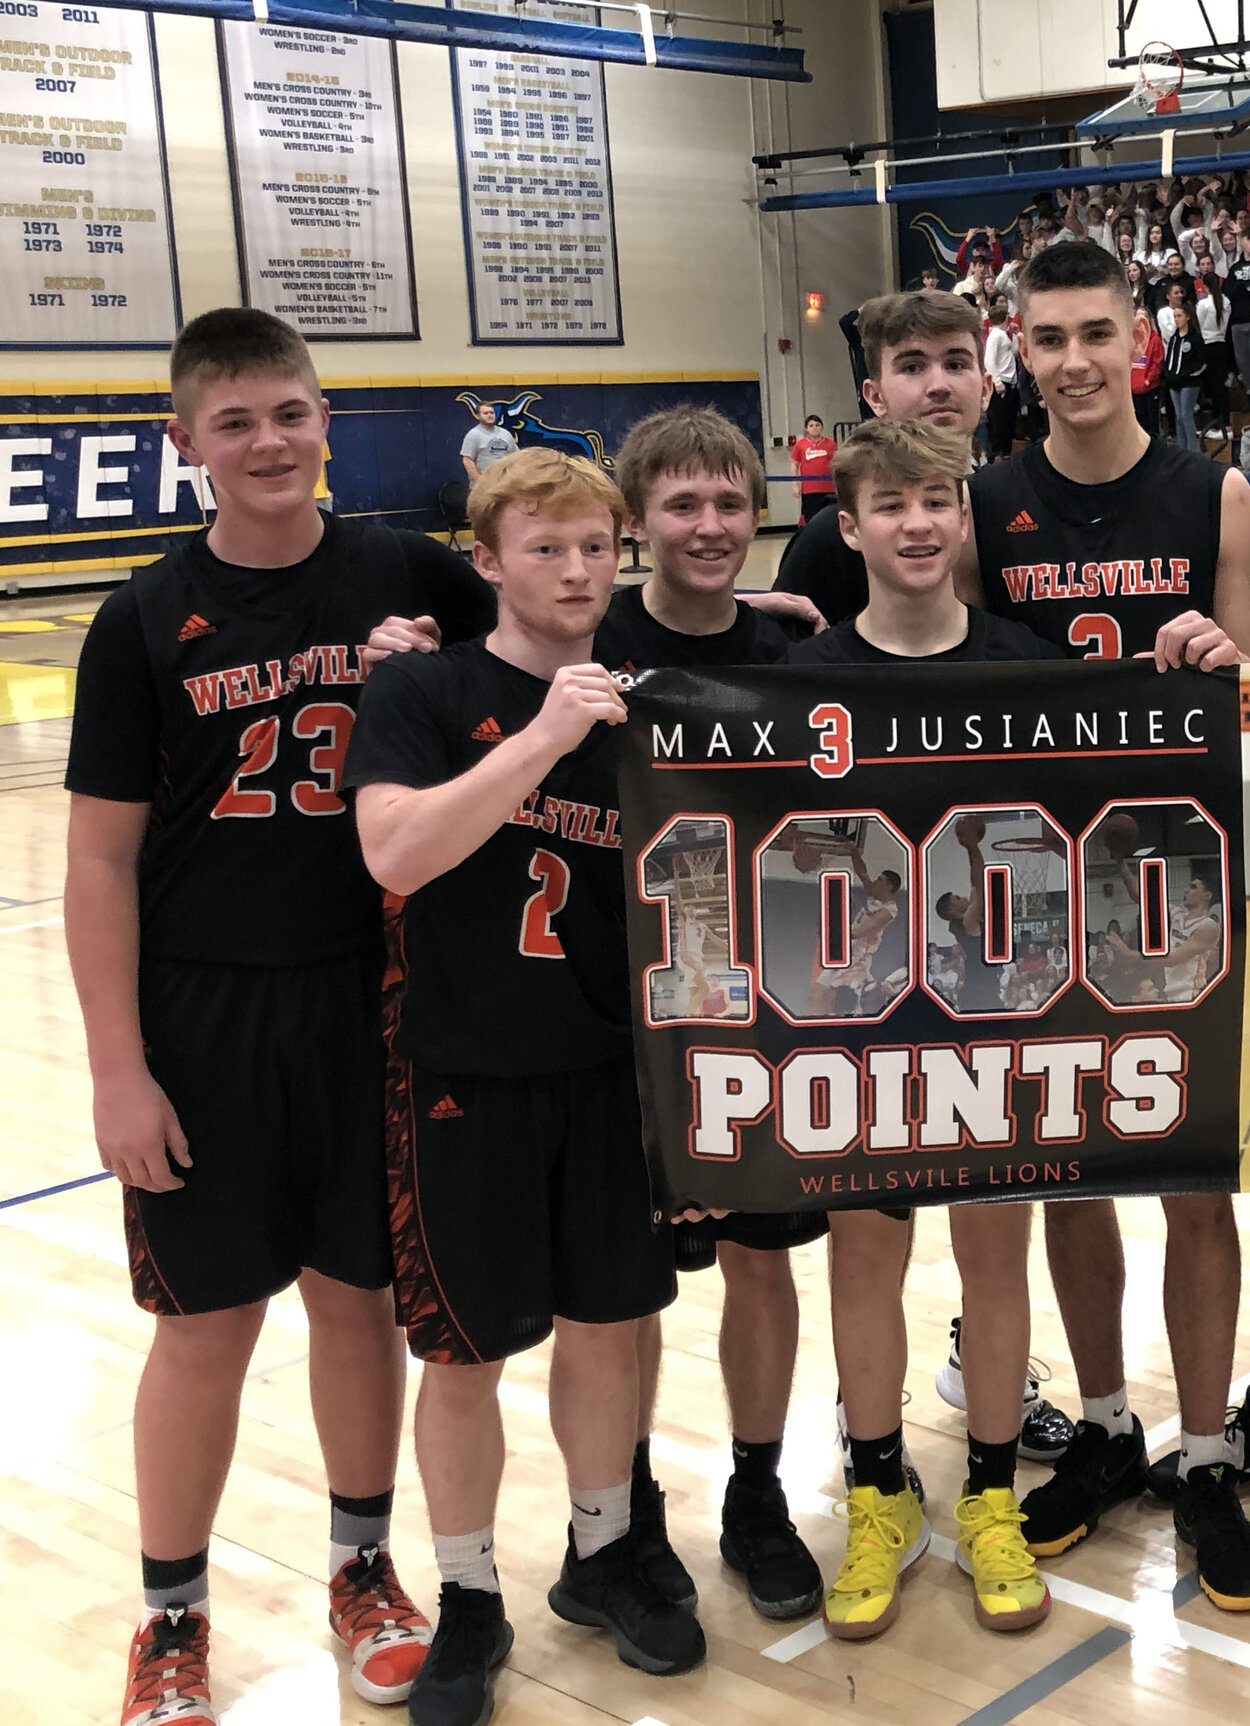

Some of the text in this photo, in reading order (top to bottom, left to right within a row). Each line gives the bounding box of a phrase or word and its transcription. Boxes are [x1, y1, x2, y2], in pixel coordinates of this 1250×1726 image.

[0, 3, 100, 24] 2003 2011
[259, 28, 301, 39] WOMEN'S
[303, 33, 336, 43] SOCCER
[55, 45, 132, 64] OUTDOOR
[274, 41, 324, 53] WRESTLING
[68, 63, 116, 80] FIELD
[521, 65, 539, 73] 2001
[35, 78, 76, 93] 2007
[253, 82, 280, 91] MEN'S
[283, 84, 312, 93] CROSS
[314, 87, 351, 97] COUNTRY
[244, 93, 287, 103] WOMEN'S
[289, 96, 317, 106] CROSS
[320, 99, 357, 109] COUNTRY
[267, 106, 308, 117] WOMEN'S
[310, 109, 343, 119] SOCCER
[49, 116, 127, 135] OUTDOOR
[281, 119, 332, 129] VOLLEYBALL
[75, 135, 123, 151] FIELD
[259, 129, 300, 139] WOMEN'S
[303, 132, 354, 142] BASKETBALL
[283, 143, 333, 152] WRESTLING
[42, 151, 86, 165] 2000
[41, 187, 94, 203] MEN'S
[263, 183, 290, 192] MEN'S
[292, 185, 320, 193] CROSS
[322, 186, 360, 195] COUNTRY
[276, 195, 316, 205] WOMEN'S
[318, 197, 349, 206] SOCCER
[289, 208, 339, 217] VOLLEYBALL
[23, 222, 122, 237] 1971 1972
[291, 218, 341, 227] WRESTLING
[23, 239, 124, 254] 1973 1974
[269, 259, 295, 267] MEN'S
[297, 260, 326, 268] CROSS
[327, 261, 364, 269] COUNTRY
[303, 271, 331, 279] CROSS
[333, 272, 370, 280] COUNTRY
[29, 294, 127, 307] 1971 1972
[297, 294, 346, 302] VOLLEYBALL
[1005, 521, 1040, 533] adidas
[1001, 558, 1190, 603] WELLSVILLE
[652, 703, 1205, 779] MAX 3 JUSIANIEC
[210, 702, 357, 819] 23
[518, 848, 570, 959] 2
[640, 797, 1229, 1029] 1000
[687, 1031, 1189, 1161] POINTS
[800, 1161, 1081, 1194] WELLSVILE LIONS
